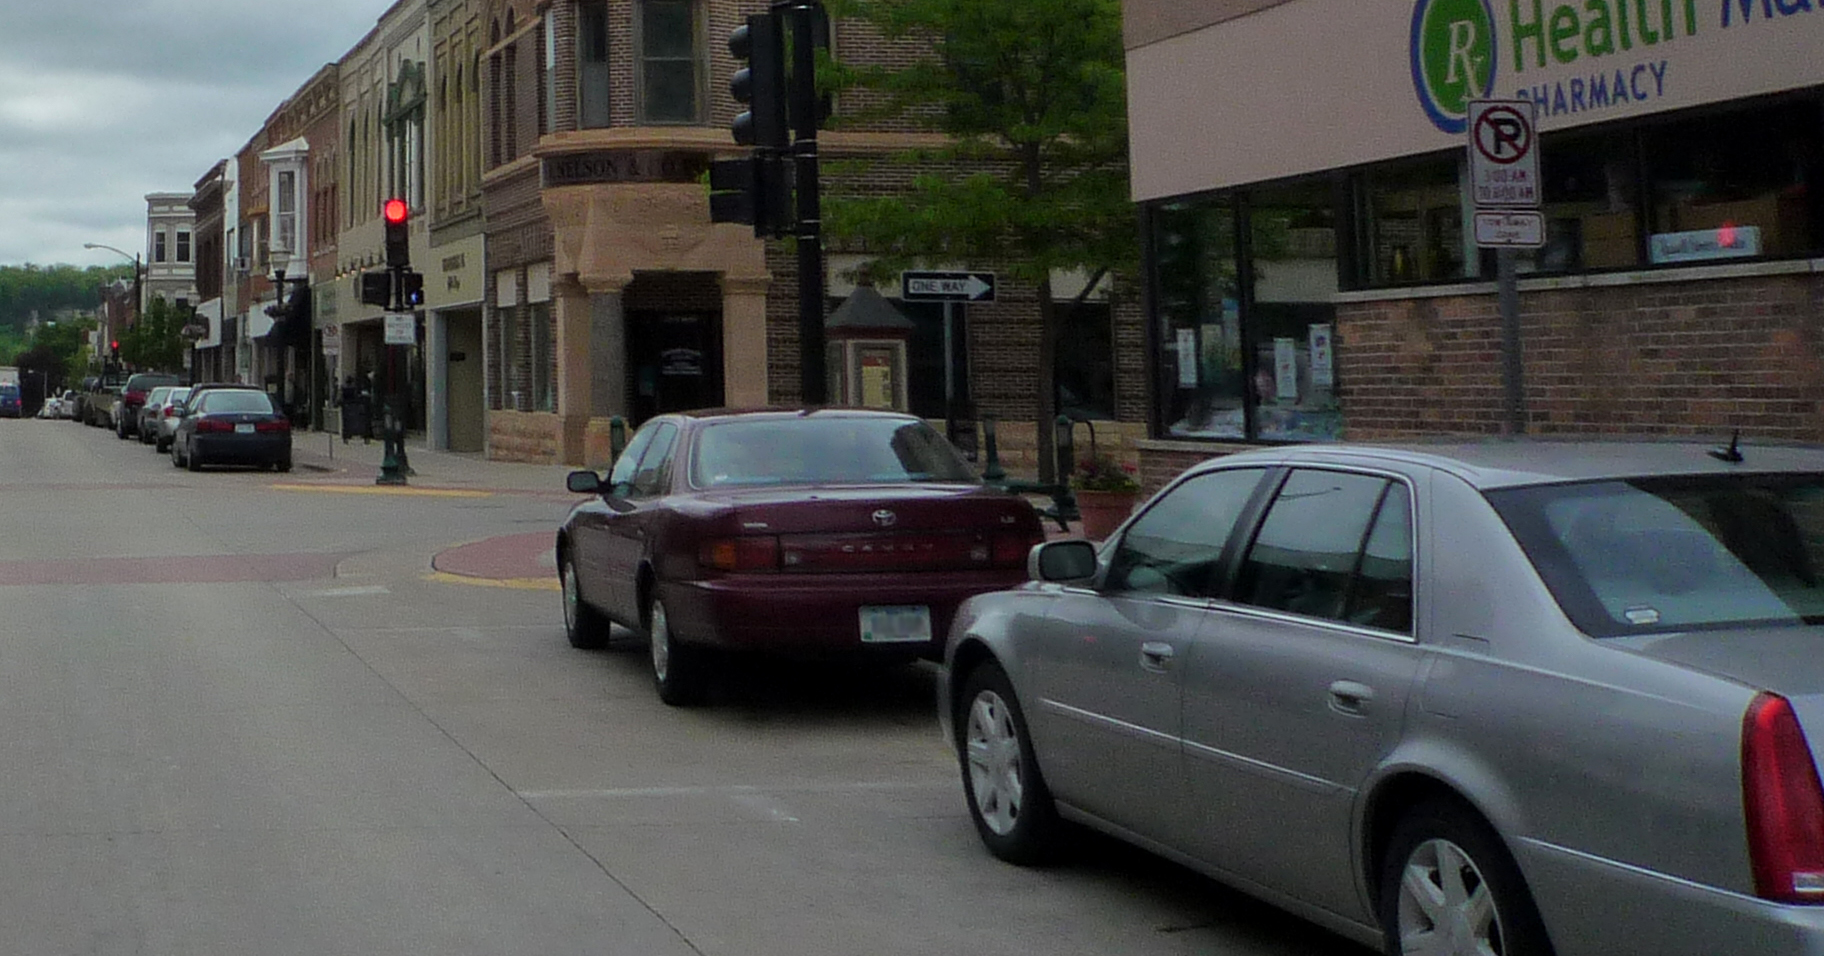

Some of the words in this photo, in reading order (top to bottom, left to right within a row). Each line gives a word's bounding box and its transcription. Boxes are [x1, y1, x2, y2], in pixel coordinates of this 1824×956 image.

[1517, 59, 1668, 119] HARMACY
[912, 281, 937, 292] ONE
[941, 281, 966, 292] WAY
